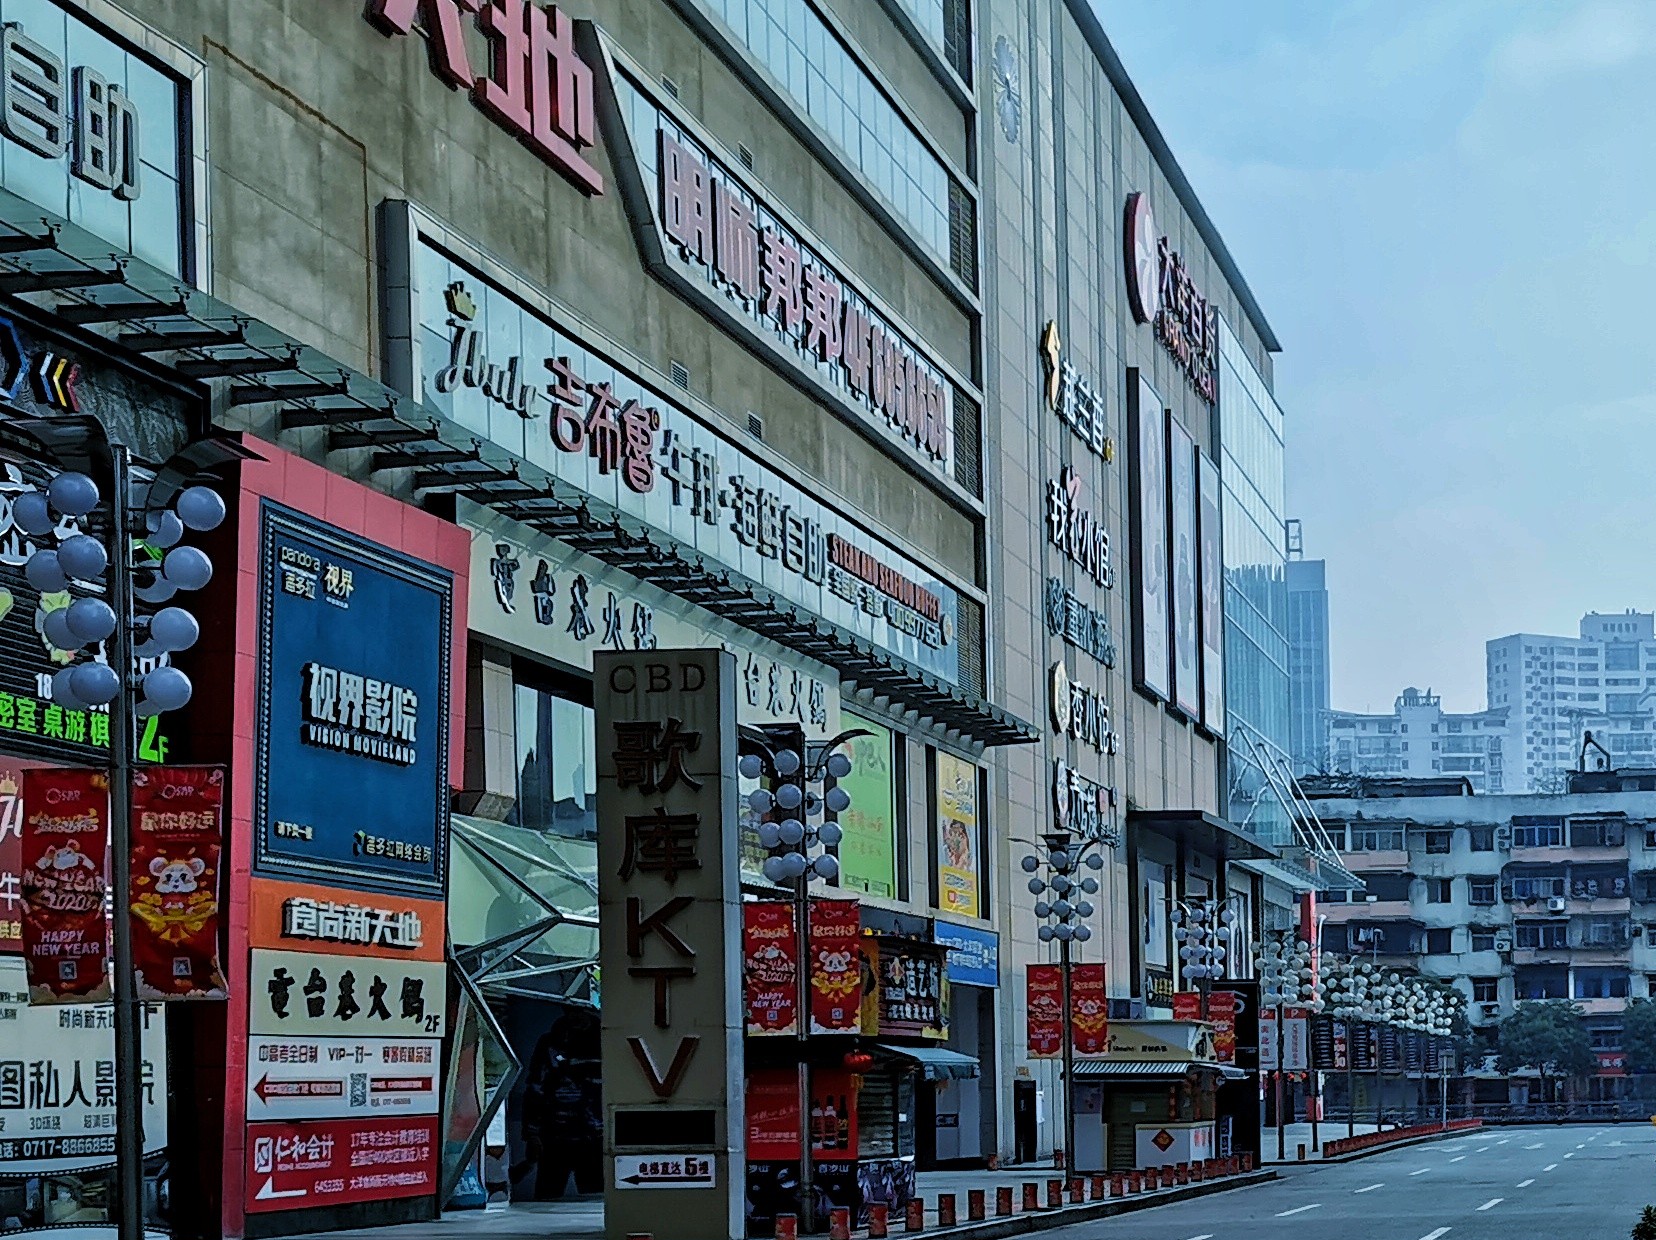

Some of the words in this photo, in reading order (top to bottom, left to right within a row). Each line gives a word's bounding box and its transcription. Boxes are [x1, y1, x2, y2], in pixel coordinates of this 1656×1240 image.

[2, 22, 141, 201] 自助
[609, 664, 706, 694] CBD
[309, 662, 418, 743] 视界影院
[309, 724, 350, 748] VISION
[353, 735, 417, 765] MOVIELAND
[41, 929, 84, 943] HAPPY
[288, 896, 424, 948] 食尚新天地
[33, 945, 62, 956] NEW
[64, 942, 100, 955] YEAR
[424, 1015, 441, 1033] 2F
